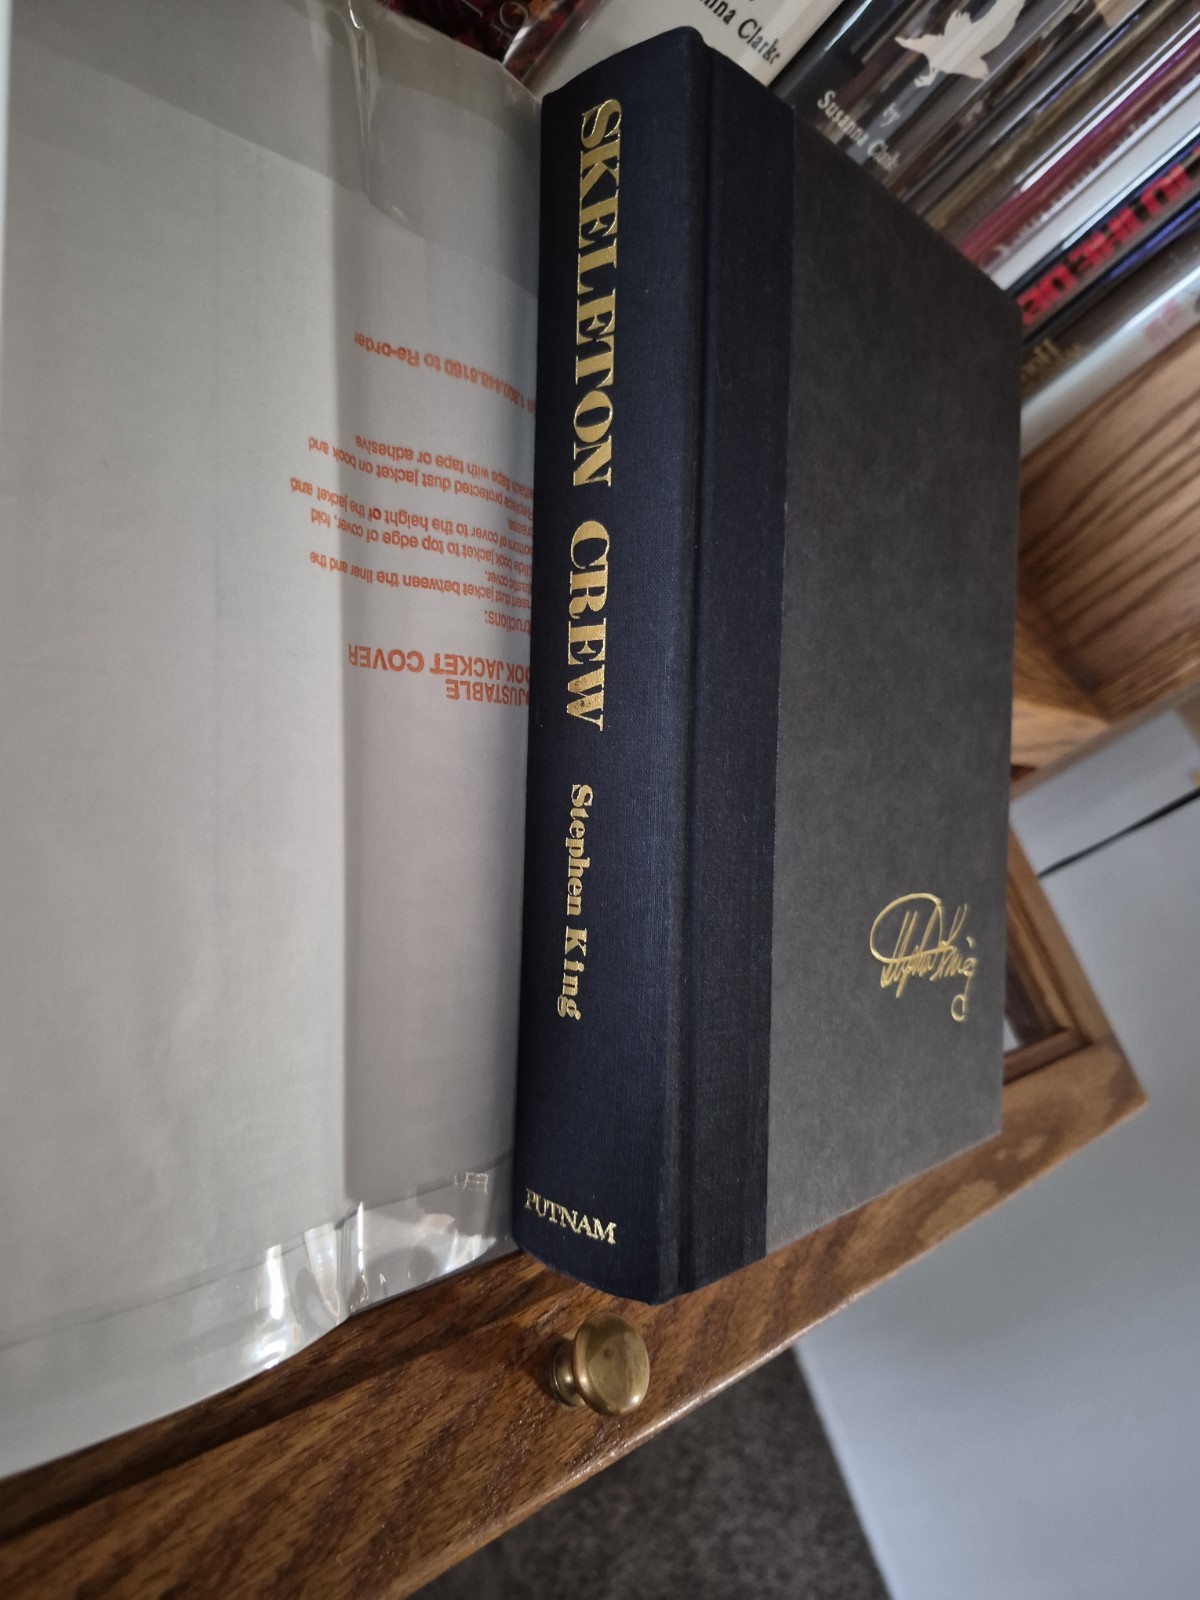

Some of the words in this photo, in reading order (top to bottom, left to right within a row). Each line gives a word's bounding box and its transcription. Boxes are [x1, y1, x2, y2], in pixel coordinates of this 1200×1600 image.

[817, 90, 869, 147] Susanna
[573, 98, 622, 487] SKELETON
[354, 331, 421, 368] Re-order
[423, 352, 441, 372] to
[308, 436, 329, 456] and
[332, 446, 357, 470] book
[358, 458, 374, 474] on
[416, 451, 433, 465] or
[435, 454, 464, 474] tape
[376, 463, 419, 487] jacket
[466, 462, 490, 479] with
[289, 477, 313, 496] and
[421, 473, 452, 492] dust
[454, 479, 503, 506] protected
[316, 487, 348, 512] jacket
[349, 500, 366, 519] the
[310, 507, 331, 528] fold
[368, 507, 382, 522] of
[384, 509, 429, 533] height
[366, 528, 380, 543] of
[431, 518, 454, 535] the
[455, 522, 468, 537] to
[471, 526, 498, 543] cover
[382, 530, 418, 549] edge
[421, 535, 445, 555] top
[446, 541, 460, 557] to
[499, 535, 508, 549] of
[309, 551, 327, 568] the
[461, 544, 494, 565] jacket
[495, 552, 513, 570] book
[329, 557, 348, 573] and
[350, 565, 373, 584] liner
[376, 570, 400, 587] the
[402, 574, 460, 596] between
[509, 579, 531, 596] lastic
[462, 583, 494, 602] jacket
[495, 590, 511, 607] dust
[511, 595, 531, 610] nsert
[484, 610, 531, 636] tructions:
[565, 520, 610, 732] CREW
[348, 643, 425, 673] COVER
[429, 652, 503, 680] JACKET
[507, 664, 530, 685] OOK
[445, 678, 529, 706] JUSTABLE
[565, 783, 594, 916] Stephen
[556, 926, 588, 1020] King
[524, 1188, 617, 1245] PUTNAM
